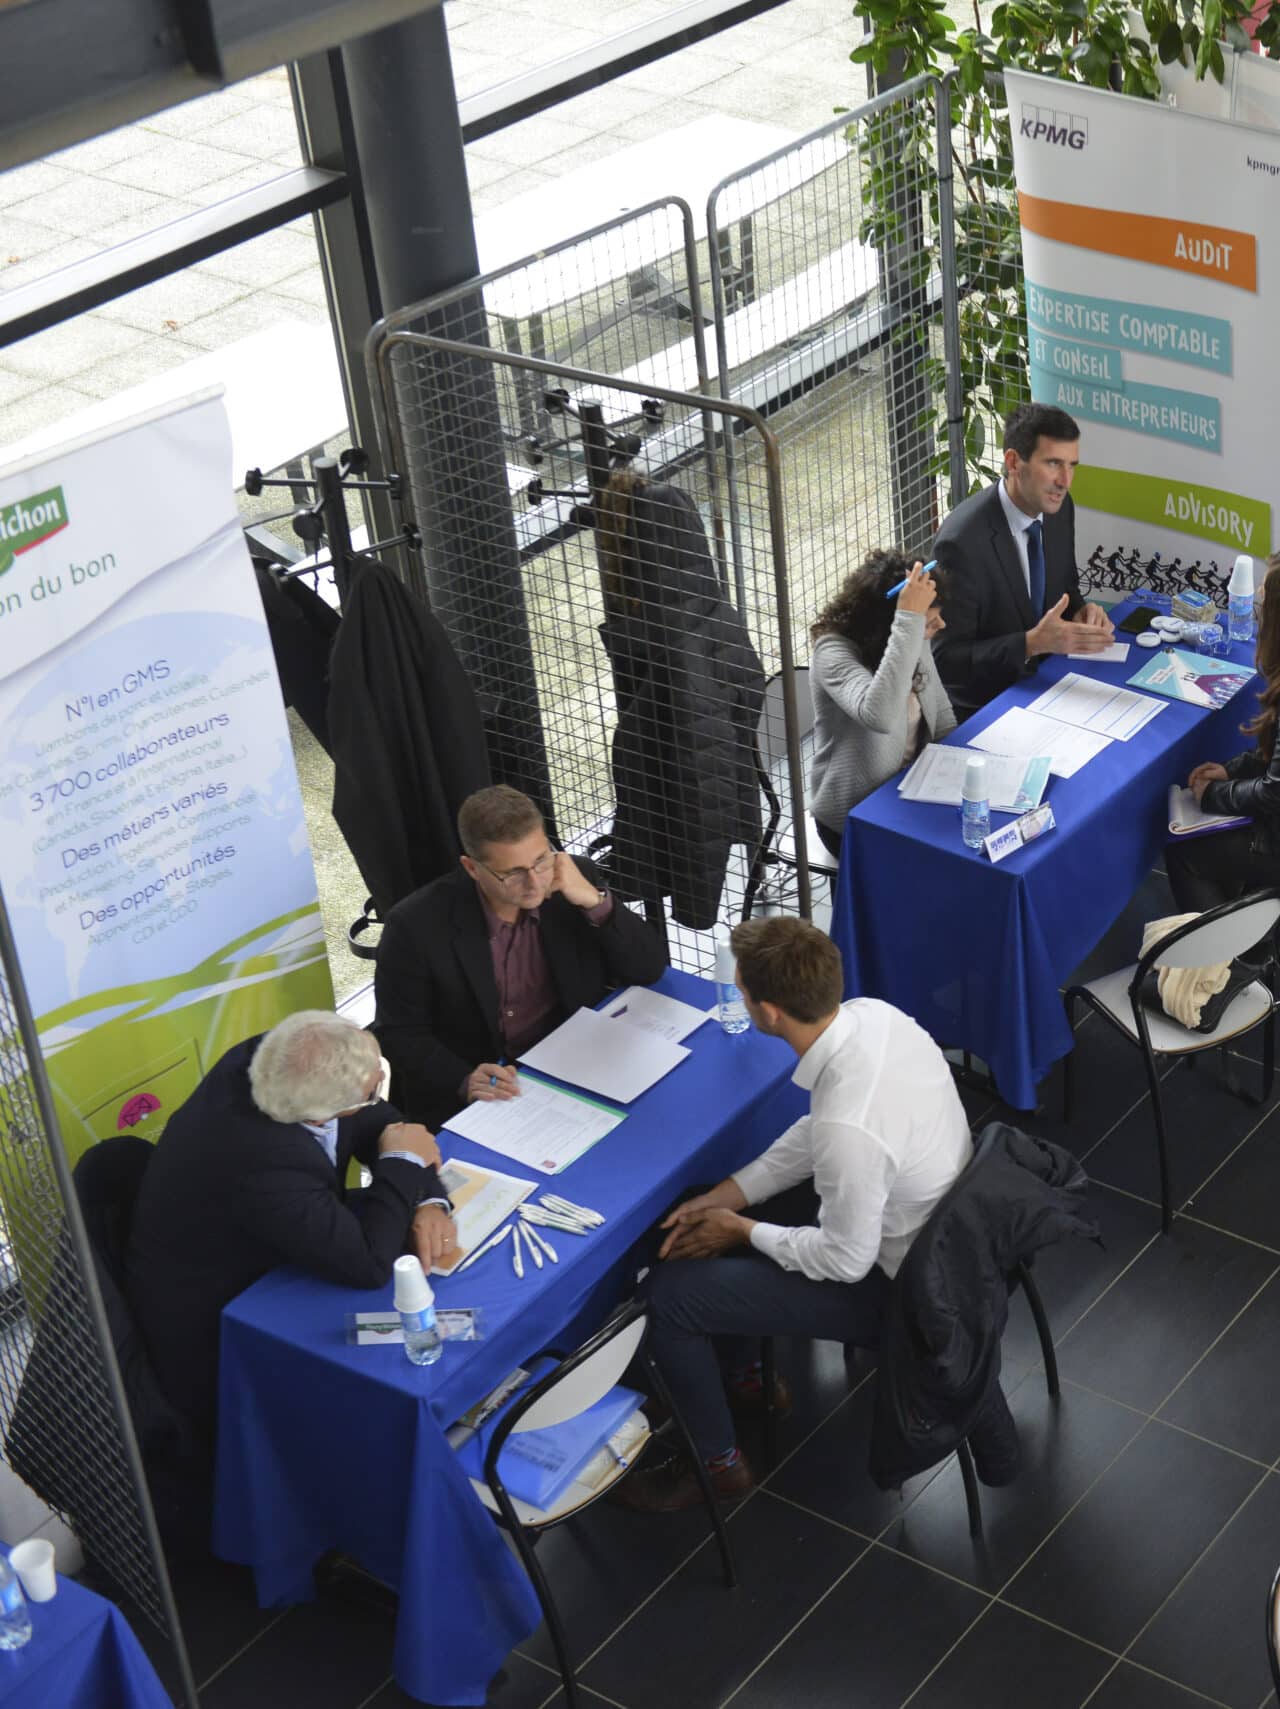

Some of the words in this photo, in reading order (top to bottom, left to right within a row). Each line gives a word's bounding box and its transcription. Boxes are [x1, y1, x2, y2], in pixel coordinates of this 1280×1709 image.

[1020, 117, 1087, 151] KPMG
[1034, 338, 1047, 362] ET
[1053, 346, 1111, 380] CONSEIL
[1119, 313, 1221, 361] COMPTABLE
[1057, 383, 1084, 407] AUX
[1092, 390, 1217, 441] ENTREPRENEURS
[0, 499, 61, 541] ichon
[1164, 491, 1255, 547] ADVISORY
[31, 576, 62, 601] du
[69, 553, 116, 586] bon
[98, 690, 121, 709] en
[122, 660, 171, 694] GMS
[30, 791, 45, 812] 3
[46, 770, 94, 804] 700
[95, 711, 230, 783] collaborateurs
[61, 840, 100, 869] Des
[104, 804, 170, 850] métiers
[171, 779, 229, 813] variés
[63, 788, 112, 818] France
[79, 902, 118, 931] Des
[120, 842, 237, 908] opportunités
